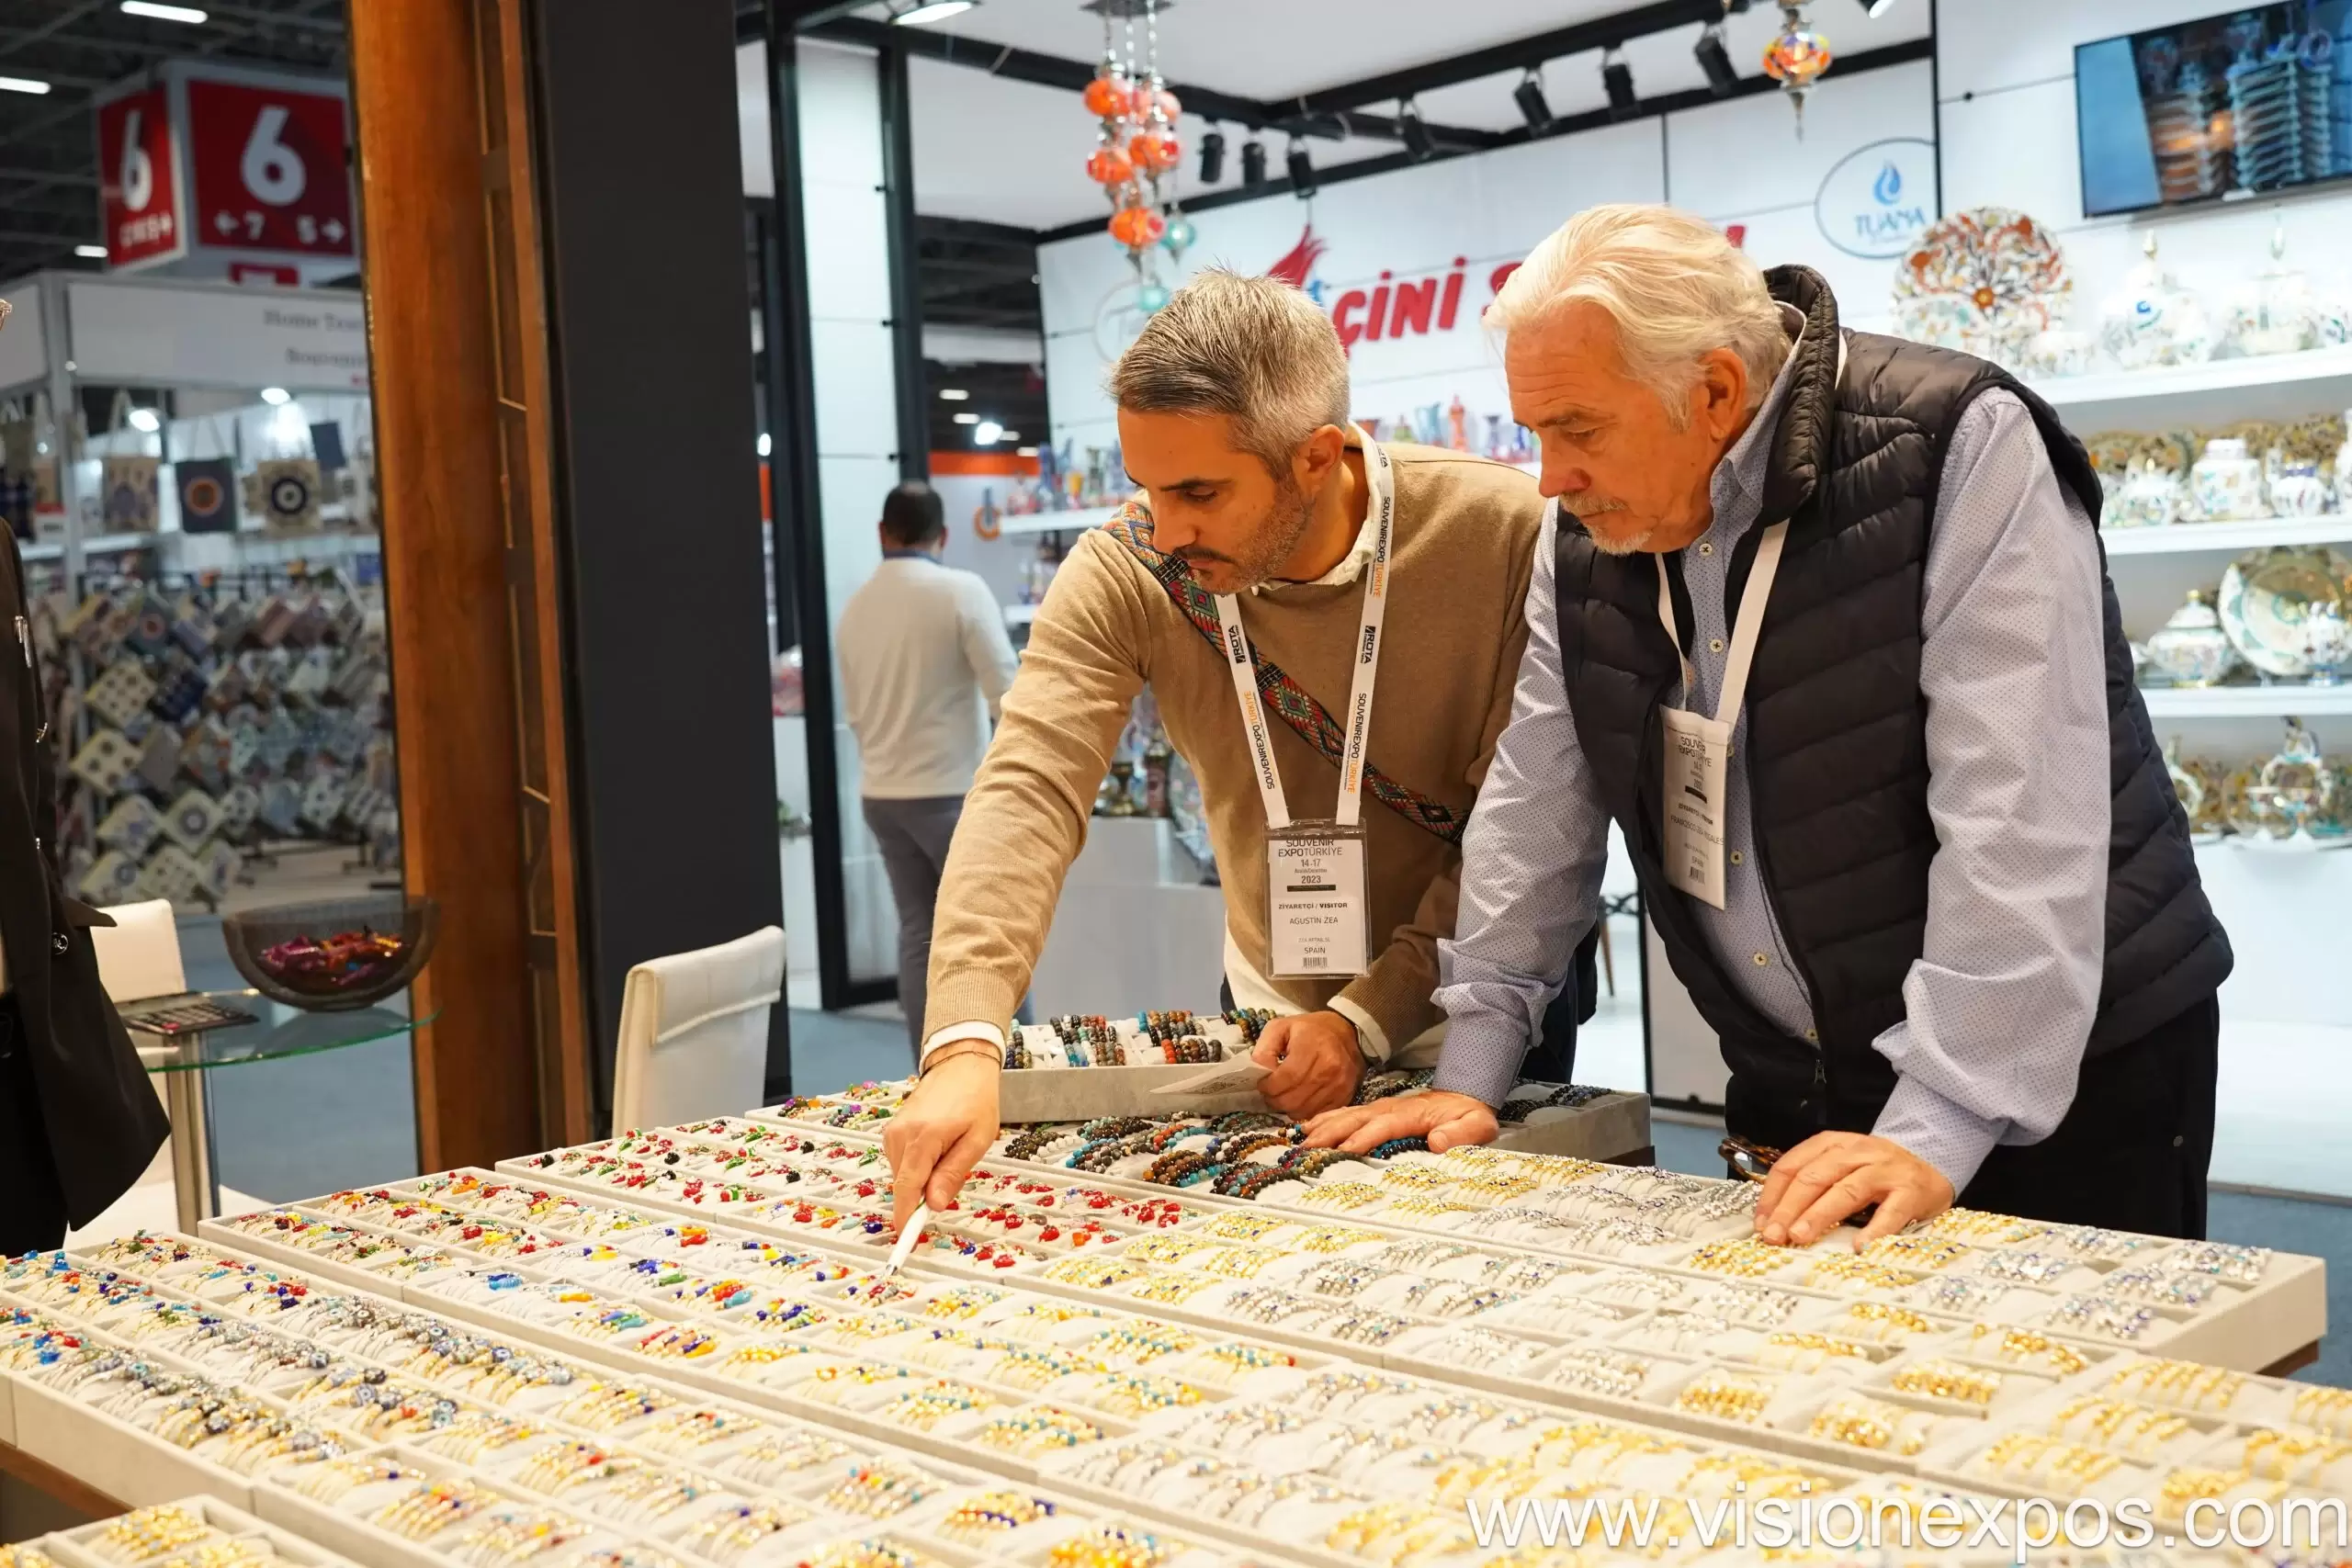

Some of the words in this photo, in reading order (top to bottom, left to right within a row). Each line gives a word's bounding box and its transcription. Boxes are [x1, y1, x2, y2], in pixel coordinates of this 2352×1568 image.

[120, 110, 152, 211] 6
[241, 105, 307, 206] 6
[243, 211, 265, 240] 7
[1228, 625, 1240, 656] ROTA
[1364, 634, 1375, 664] ROTA
[1286, 839, 1334, 847] SOUVENIR
[1301, 875, 1321, 884] 2023
[1304, 946, 1326, 954] SPAIN
